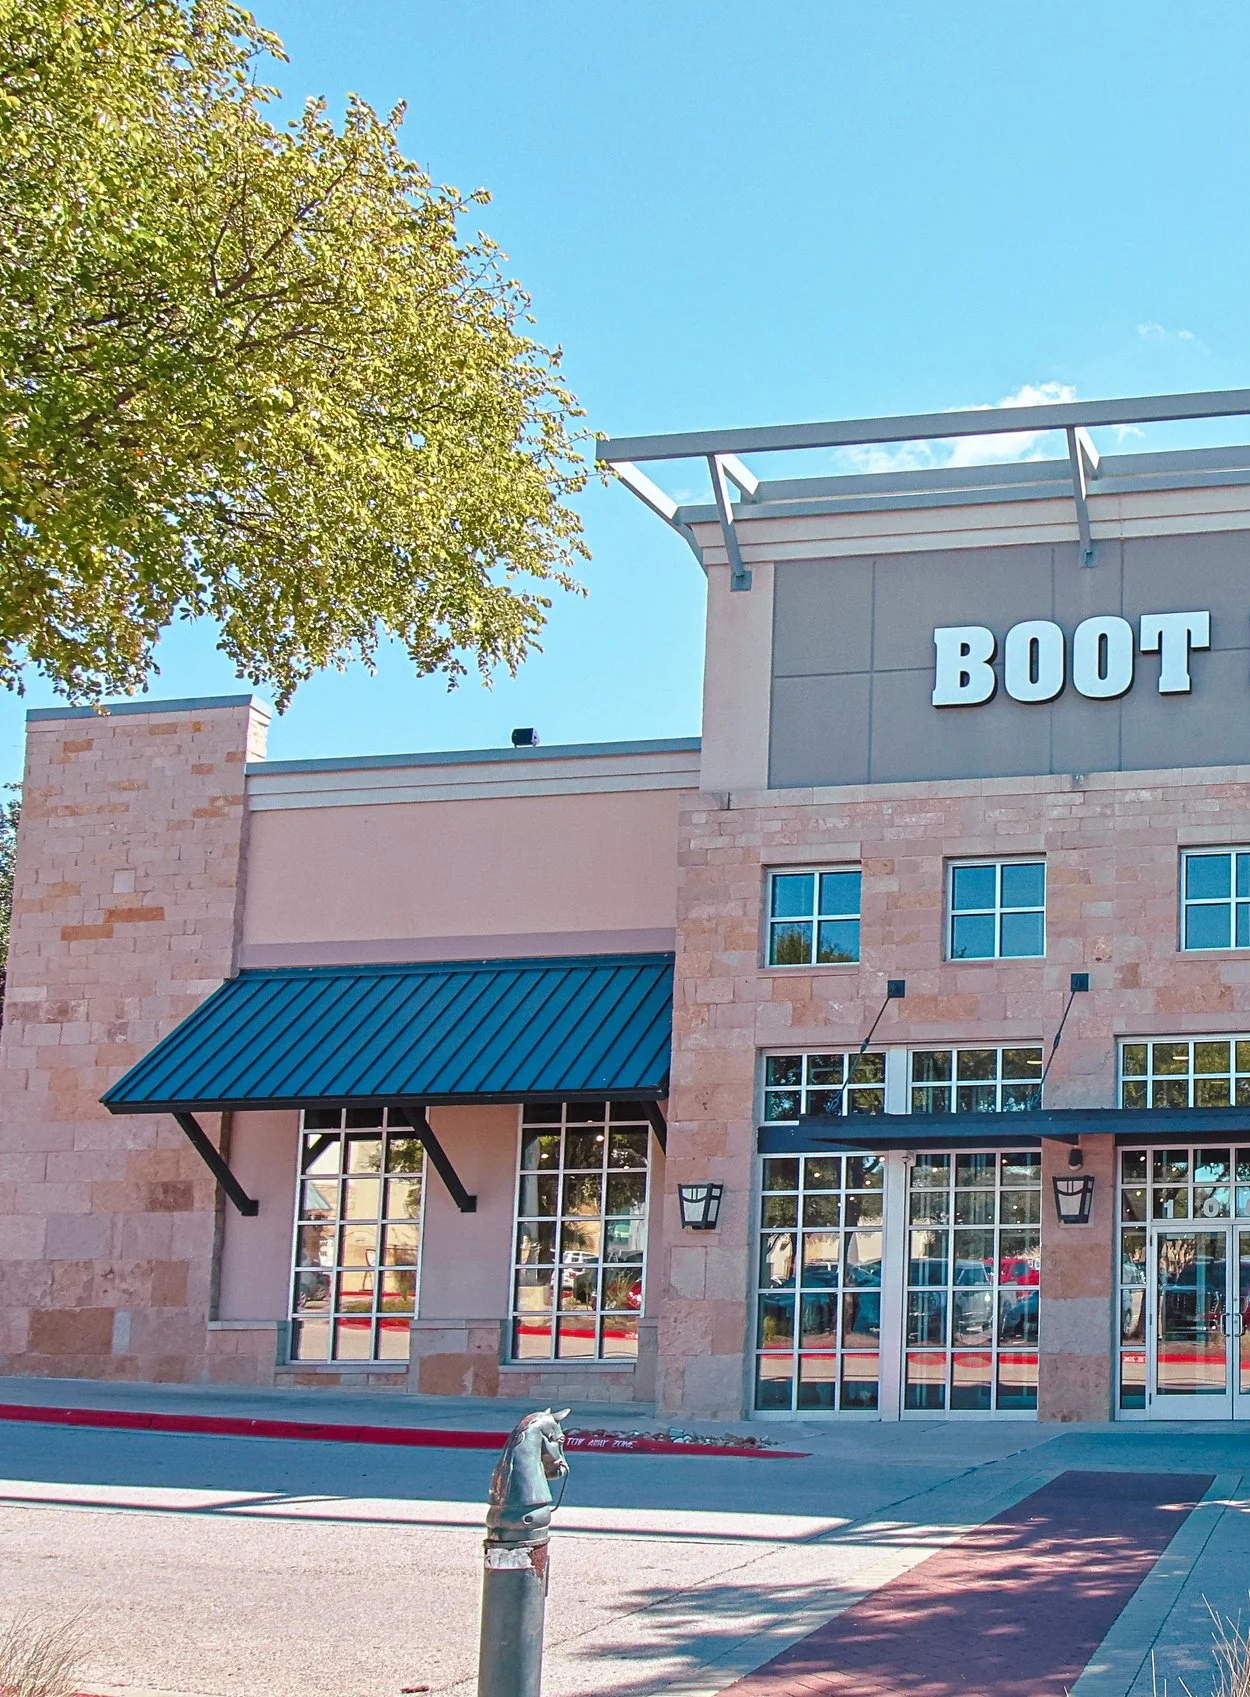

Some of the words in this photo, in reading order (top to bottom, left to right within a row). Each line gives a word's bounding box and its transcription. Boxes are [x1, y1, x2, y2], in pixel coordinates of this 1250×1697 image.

[932, 610, 1211, 708] BOOT
[566, 1437, 585, 1446] TOW
[611, 1440, 638, 1449] ZONE
